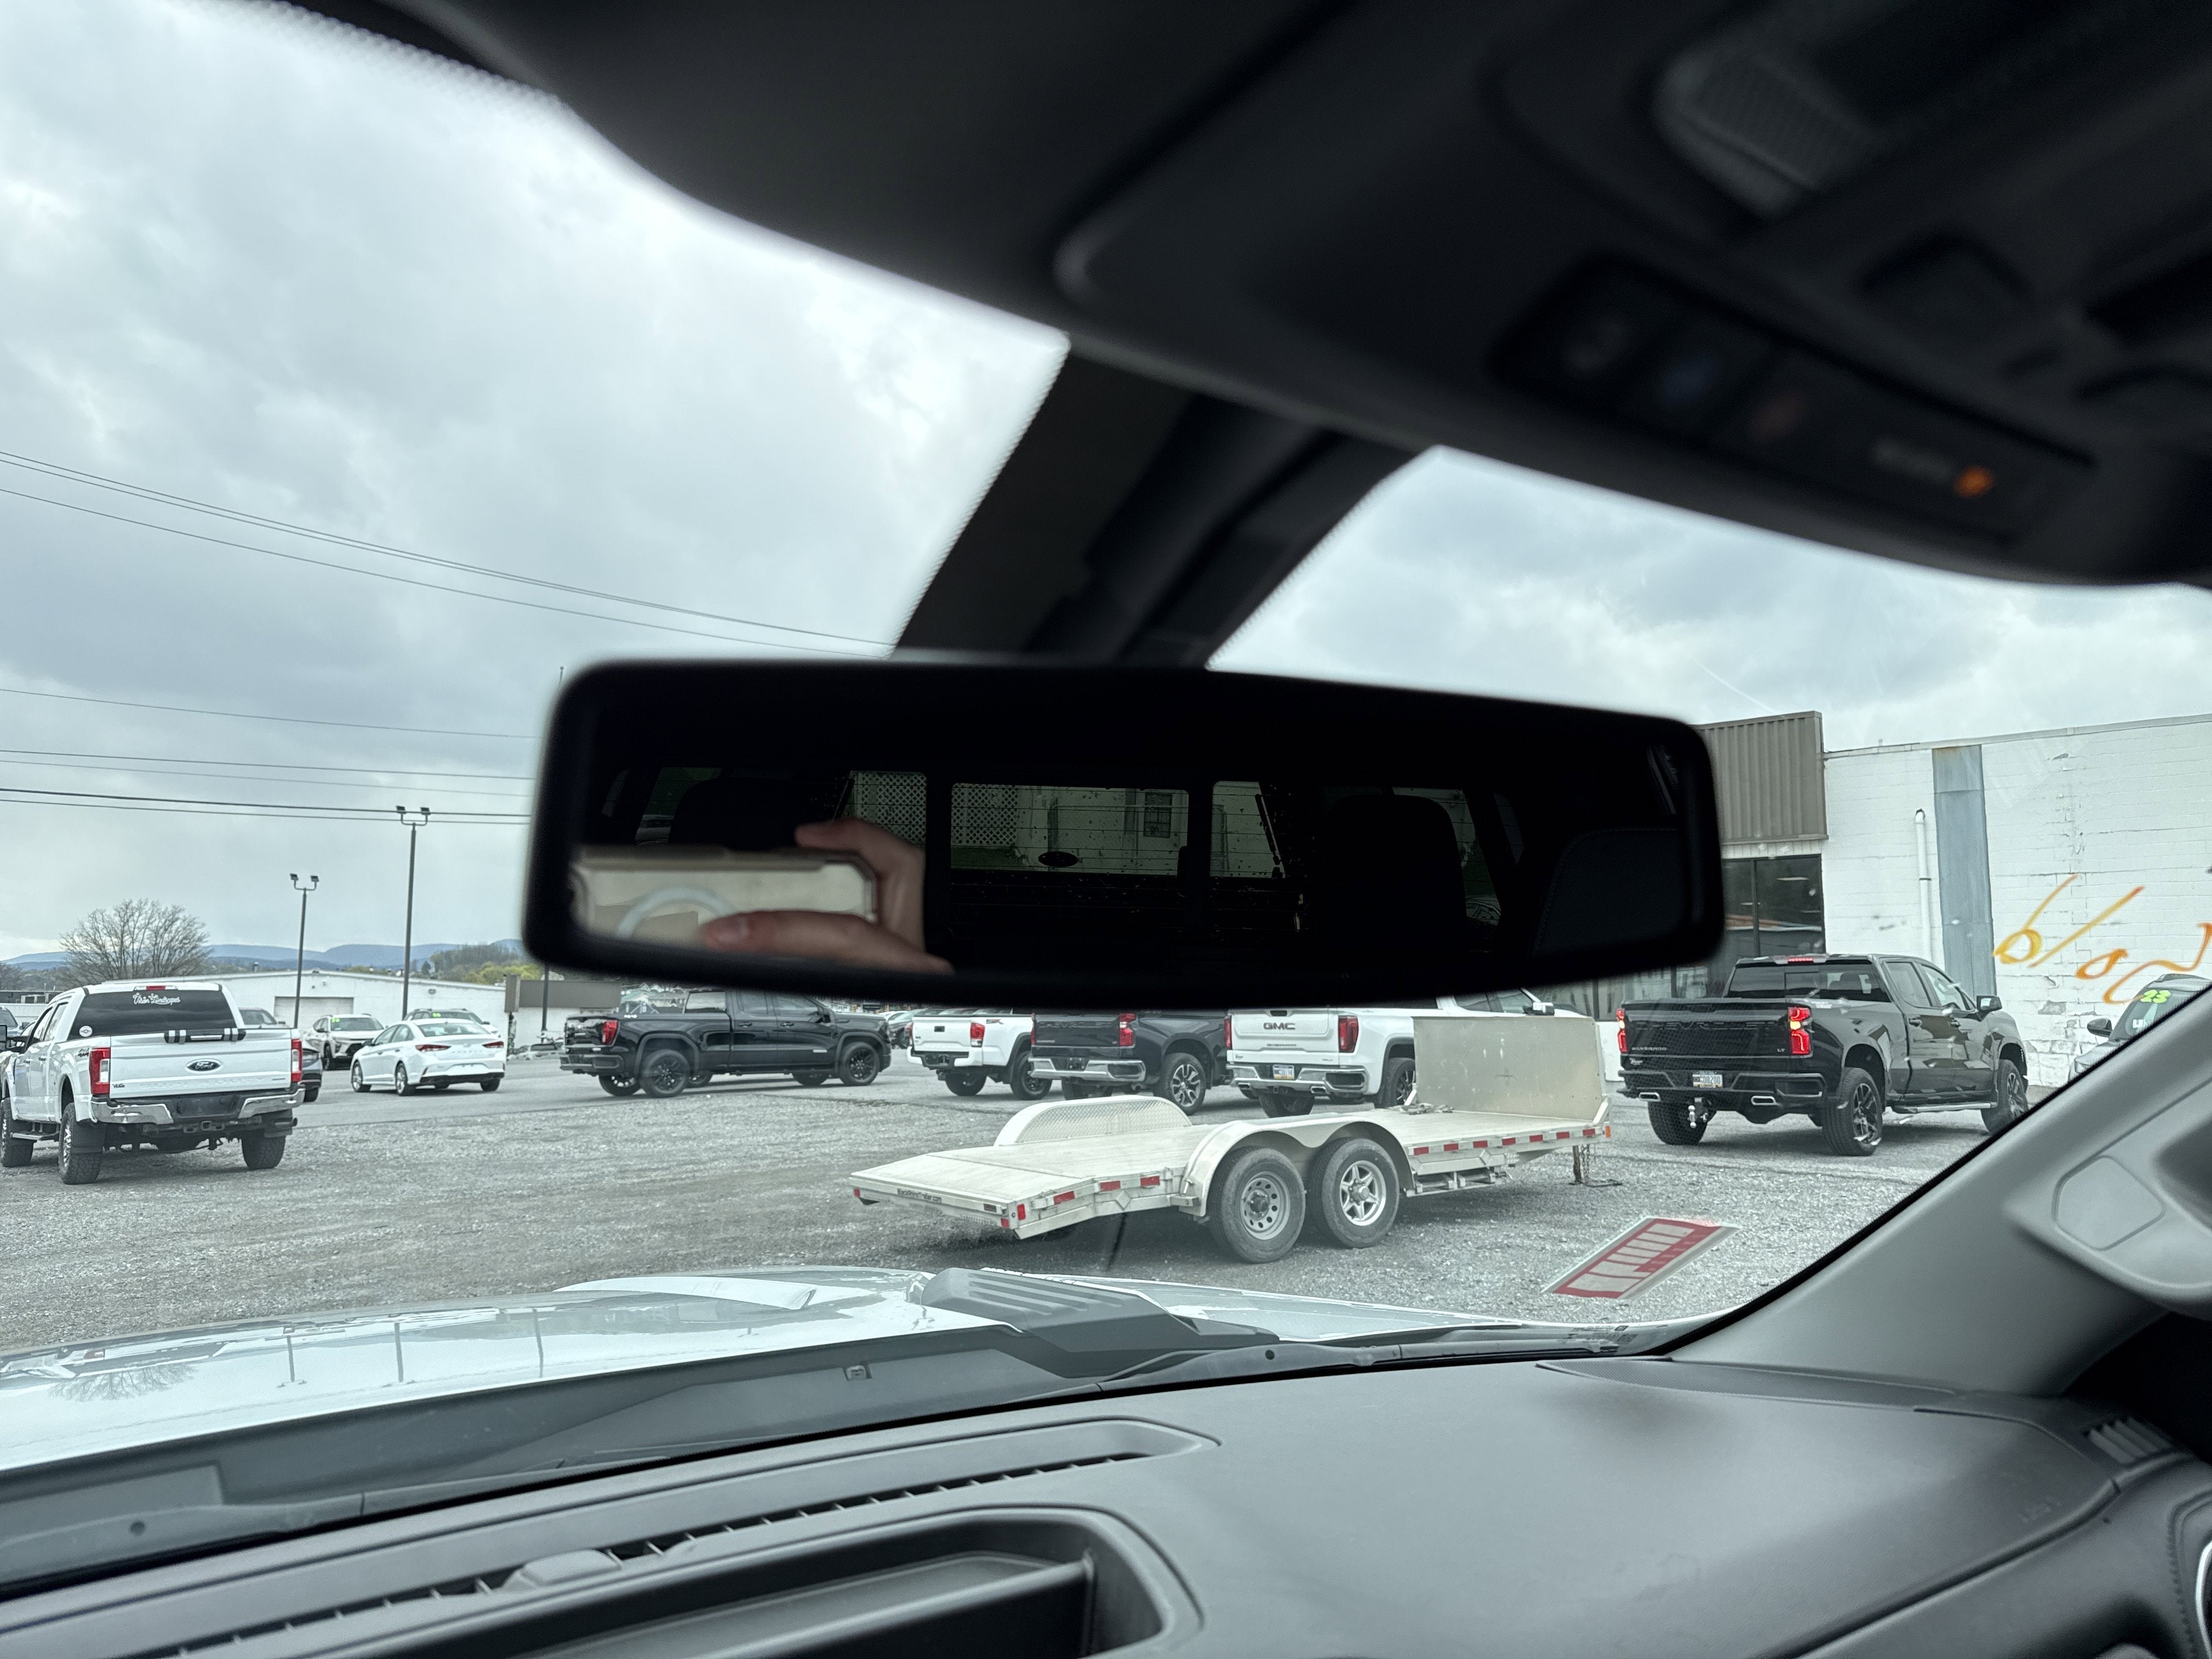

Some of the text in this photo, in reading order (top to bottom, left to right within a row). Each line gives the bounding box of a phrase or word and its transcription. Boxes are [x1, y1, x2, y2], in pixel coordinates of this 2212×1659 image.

[2141, 989, 2171, 1003] 23
[1263, 1022, 1296, 1030] GMC
[195, 1061, 214, 1069] Ford
